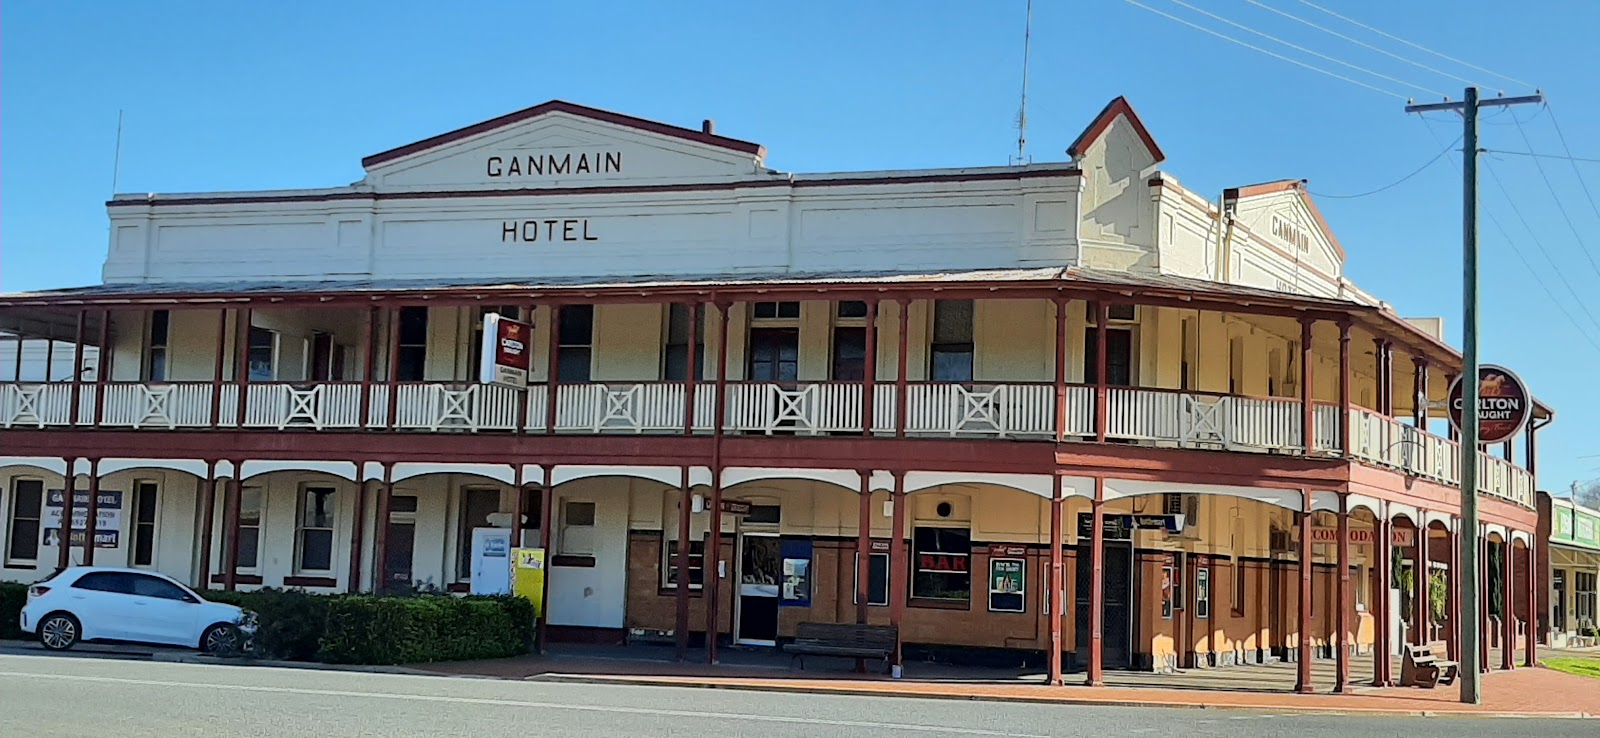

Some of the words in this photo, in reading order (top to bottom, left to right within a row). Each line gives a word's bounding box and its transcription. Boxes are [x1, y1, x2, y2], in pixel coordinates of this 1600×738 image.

[487, 152, 621, 177] GANMAIN
[502, 220, 598, 242] HOTEL
[1272, 215, 1309, 254] GANMAIN
[920, 556, 966, 570] BAR
